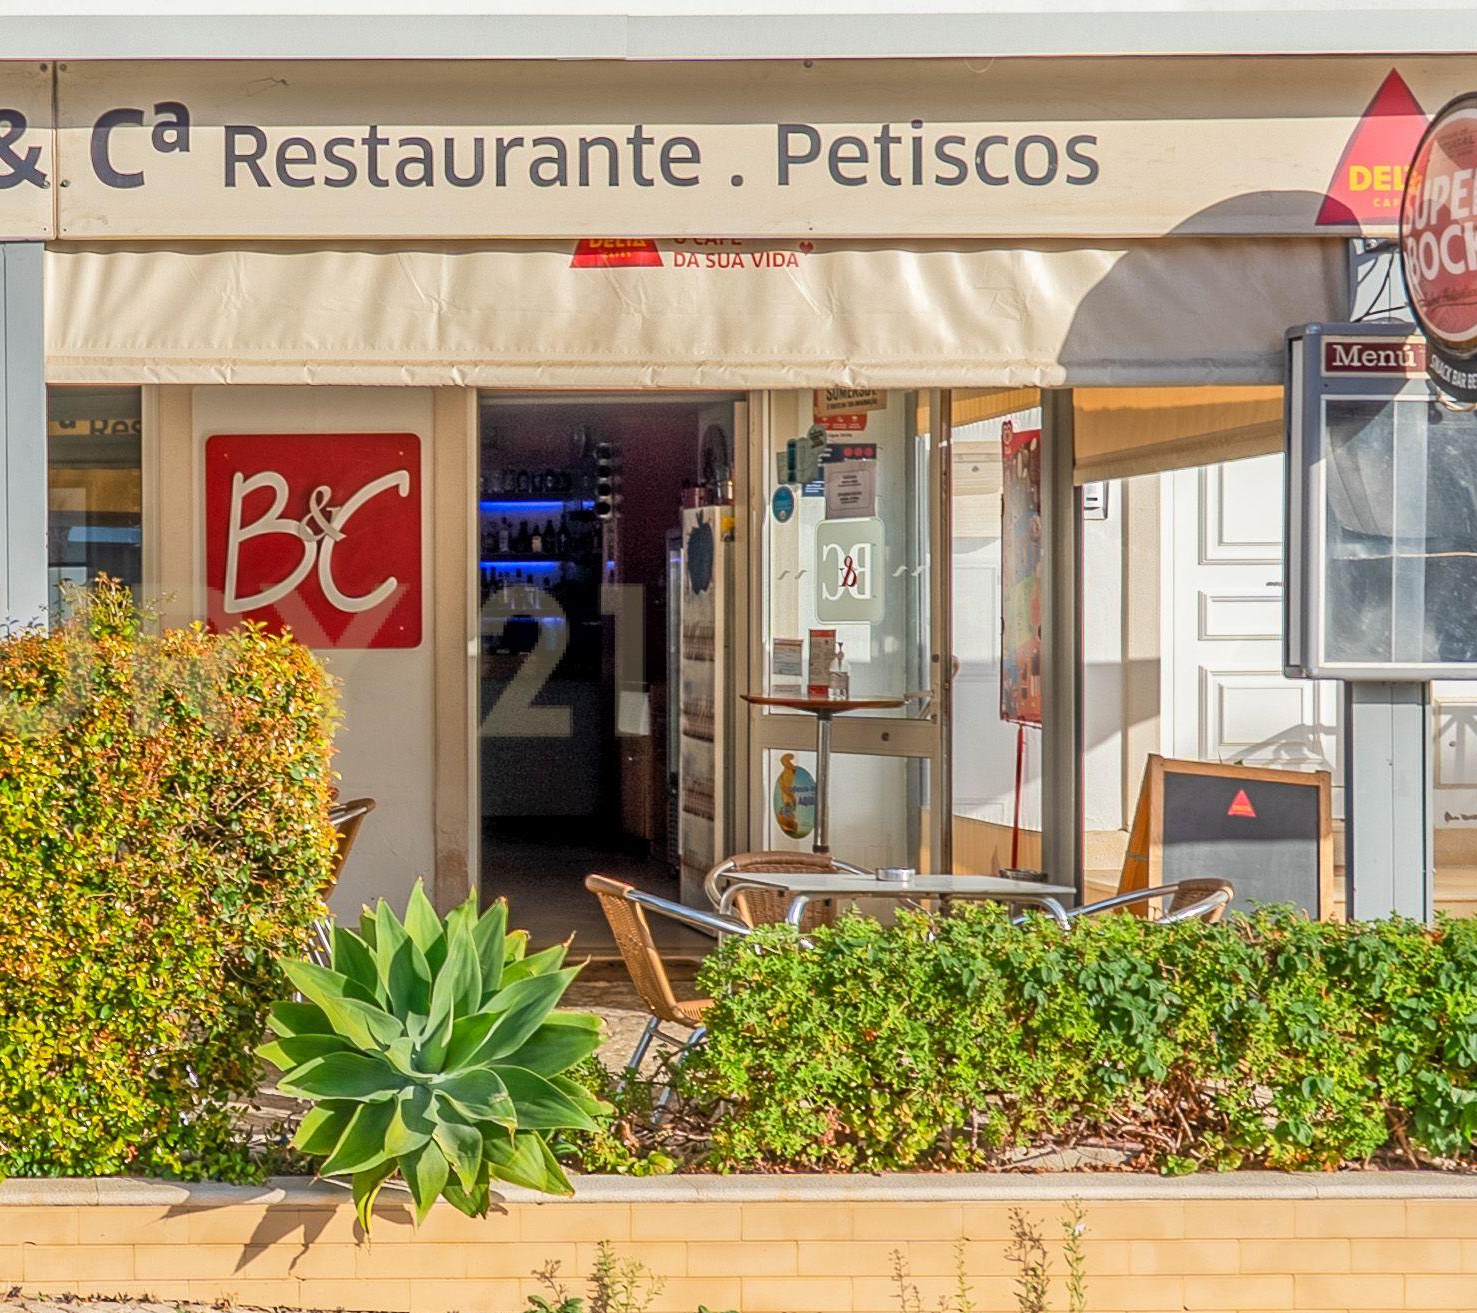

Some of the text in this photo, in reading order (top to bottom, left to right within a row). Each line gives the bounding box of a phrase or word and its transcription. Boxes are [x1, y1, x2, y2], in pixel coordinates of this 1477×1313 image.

[223, 124, 702, 188] Restaurante
[777, 119, 1100, 188] Petiscos
[673, 252, 799, 268] DA SUA VIDA
[1331, 345, 1417, 367] Menú
[1452, 369, 1467, 389] BAR
[223, 468, 411, 616] B&C
